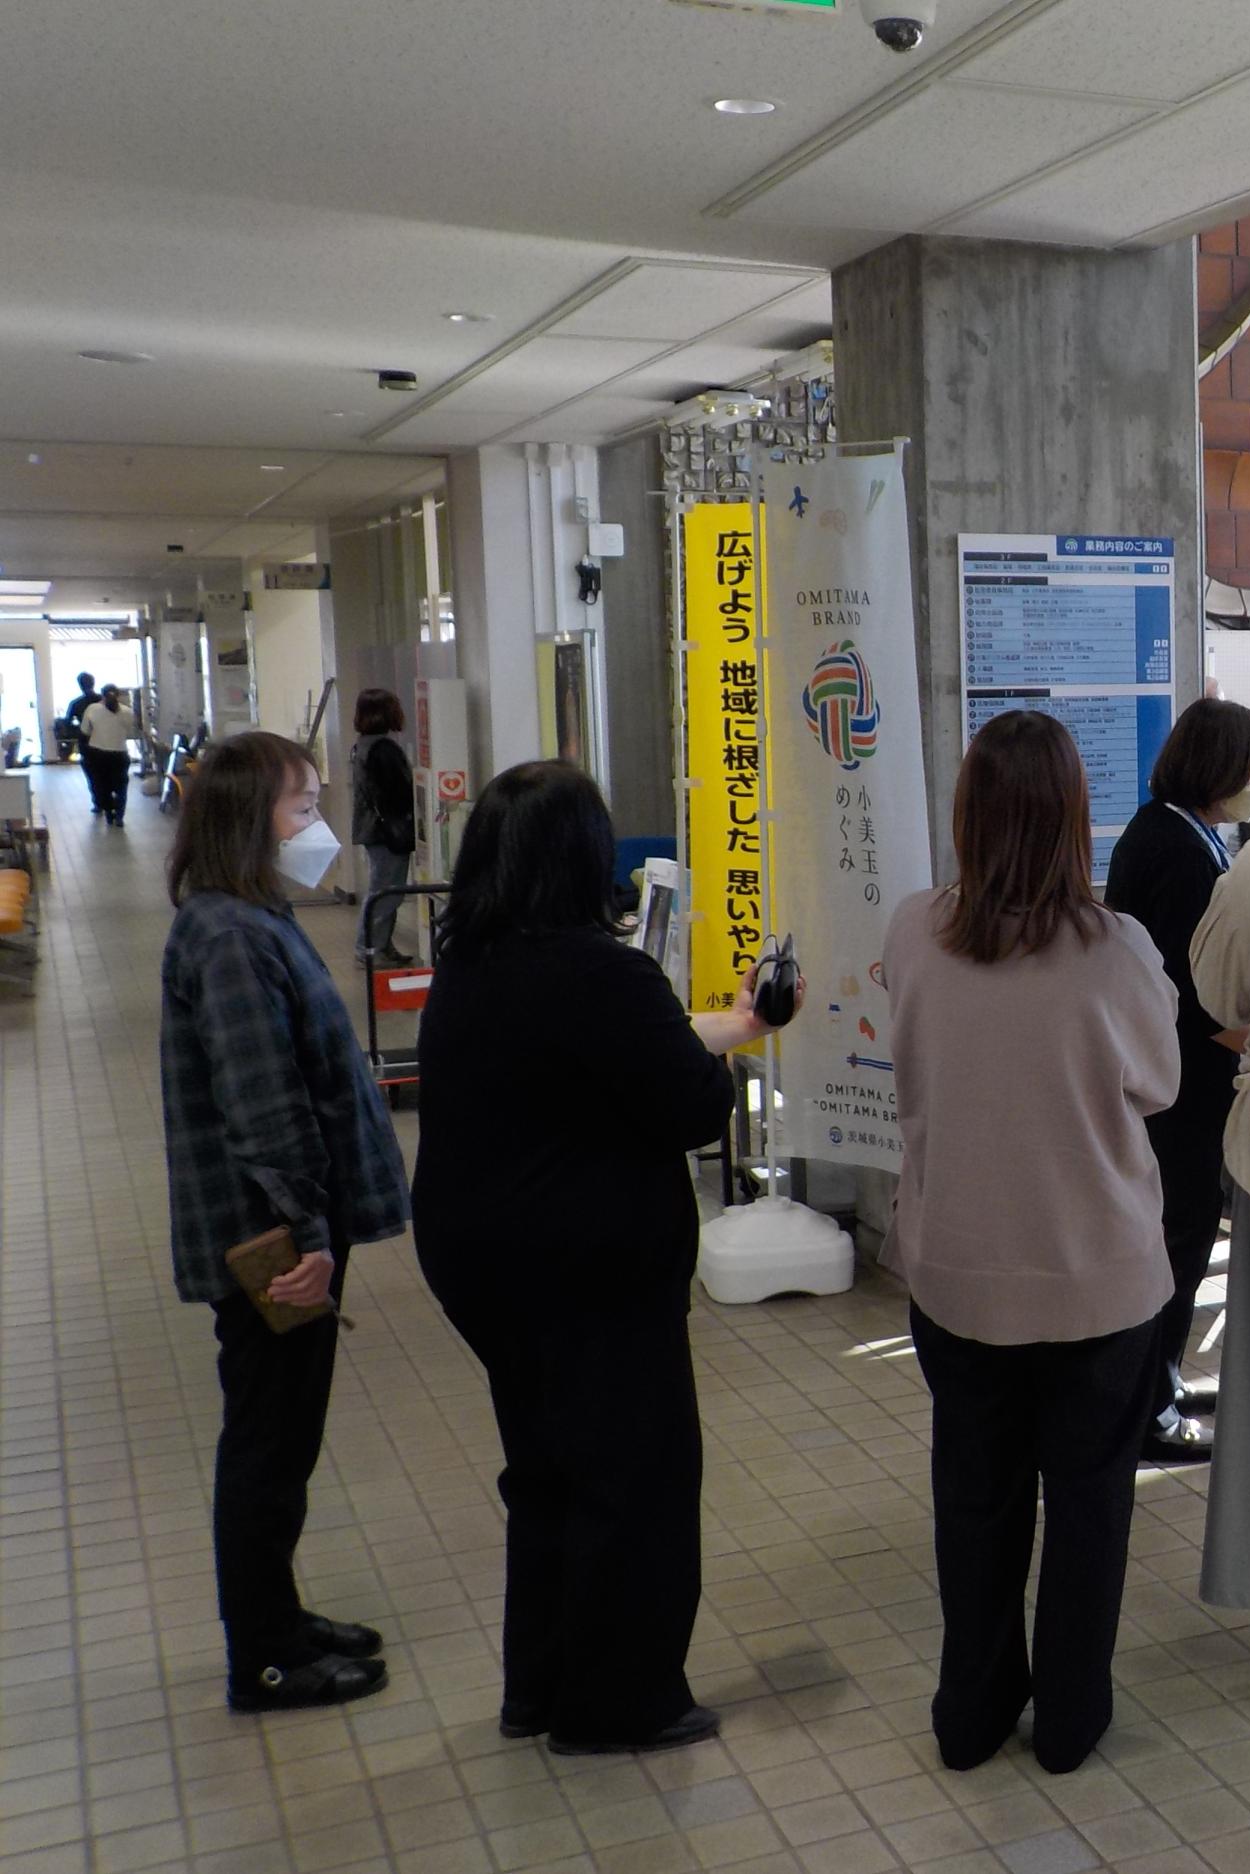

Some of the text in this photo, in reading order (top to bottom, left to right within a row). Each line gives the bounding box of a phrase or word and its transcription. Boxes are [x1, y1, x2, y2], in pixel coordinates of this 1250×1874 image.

[1084, 540, 1163, 553] 業務内容のご案内
[796, 588, 870, 606] OMITAMA
[811, 610, 861, 626] BRAND
[716, 530, 760, 976] 広げよう 地域に根ざした 思いやり
[836, 784, 856, 872] めぐみ
[858, 785, 880, 906] 小美玉の
[706, 992, 735, 1008] 小美
[825, 1083, 896, 1105] OMITAMA C
[882, 1110, 898, 1123] BR
[847, 1130, 904, 1152] 茨城県小美玉
